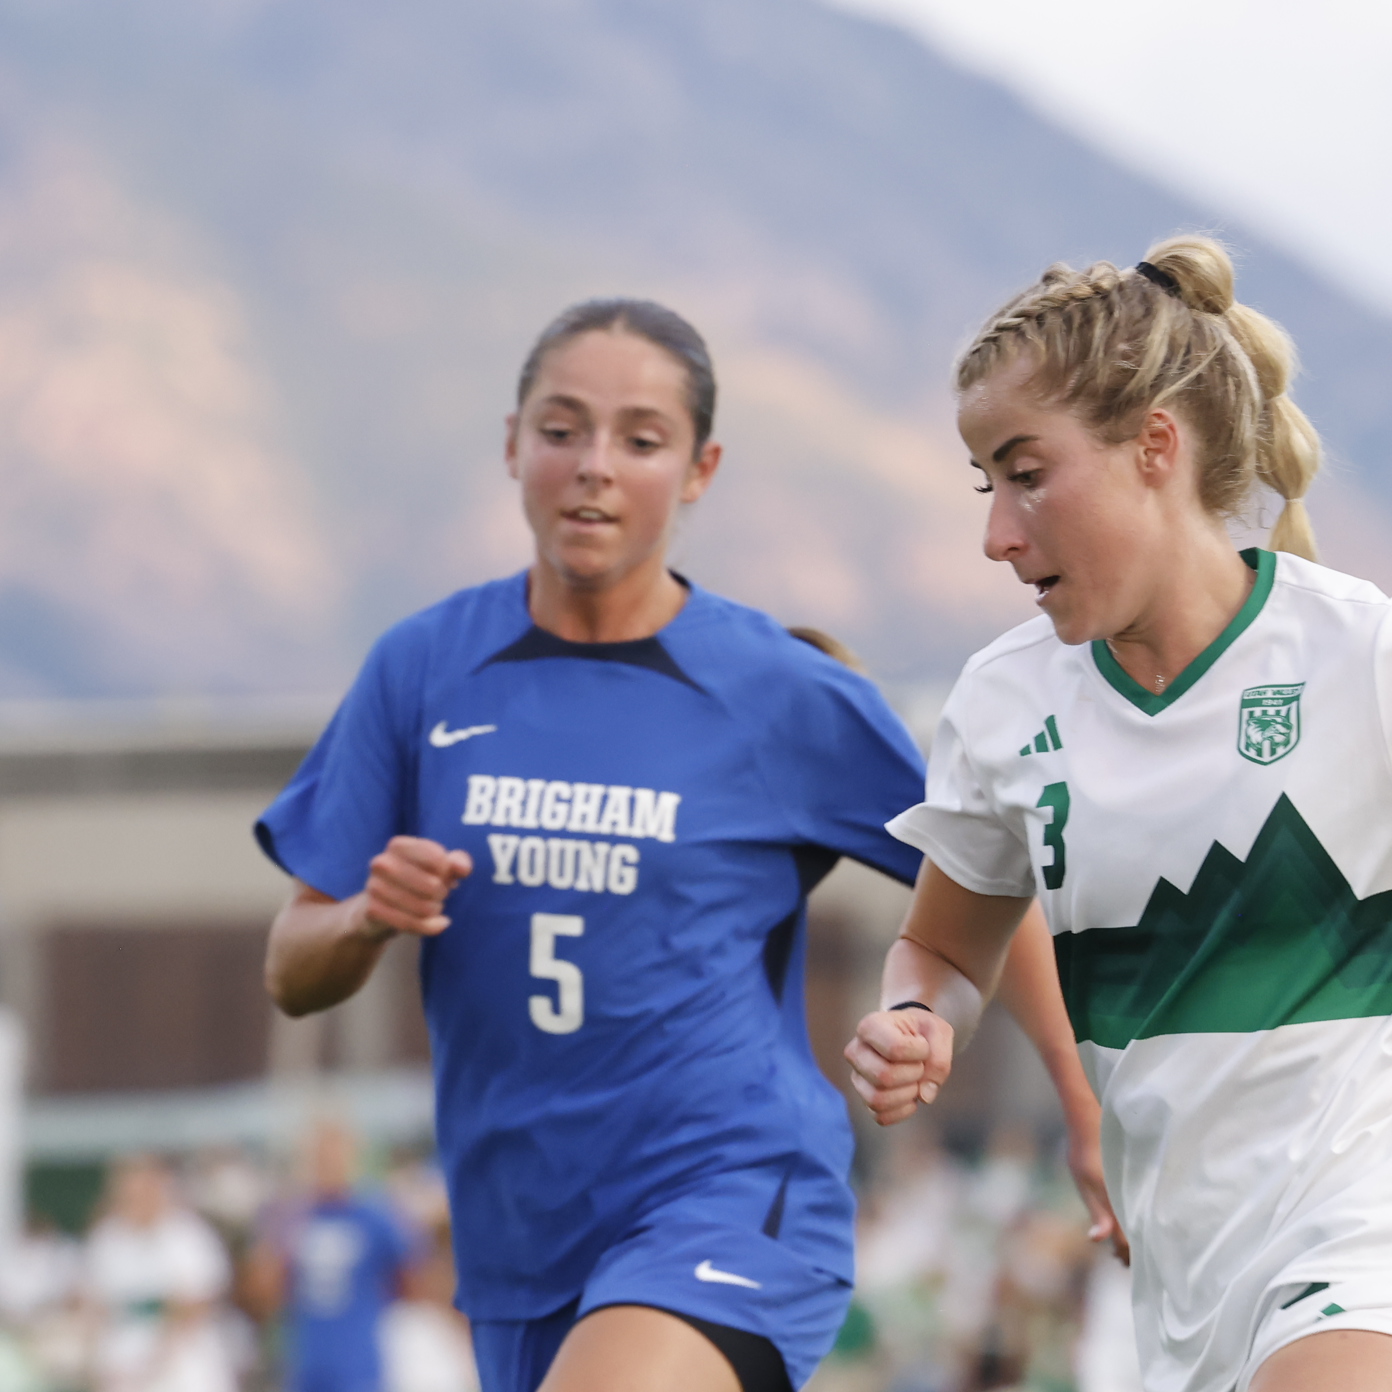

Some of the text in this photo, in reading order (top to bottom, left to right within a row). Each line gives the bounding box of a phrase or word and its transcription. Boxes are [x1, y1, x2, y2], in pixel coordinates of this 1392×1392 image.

[462, 774, 682, 843] BRIGHAM
[1035, 781, 1071, 890] 3
[488, 833, 640, 896] YOUNG
[528, 912, 585, 1035] 5
